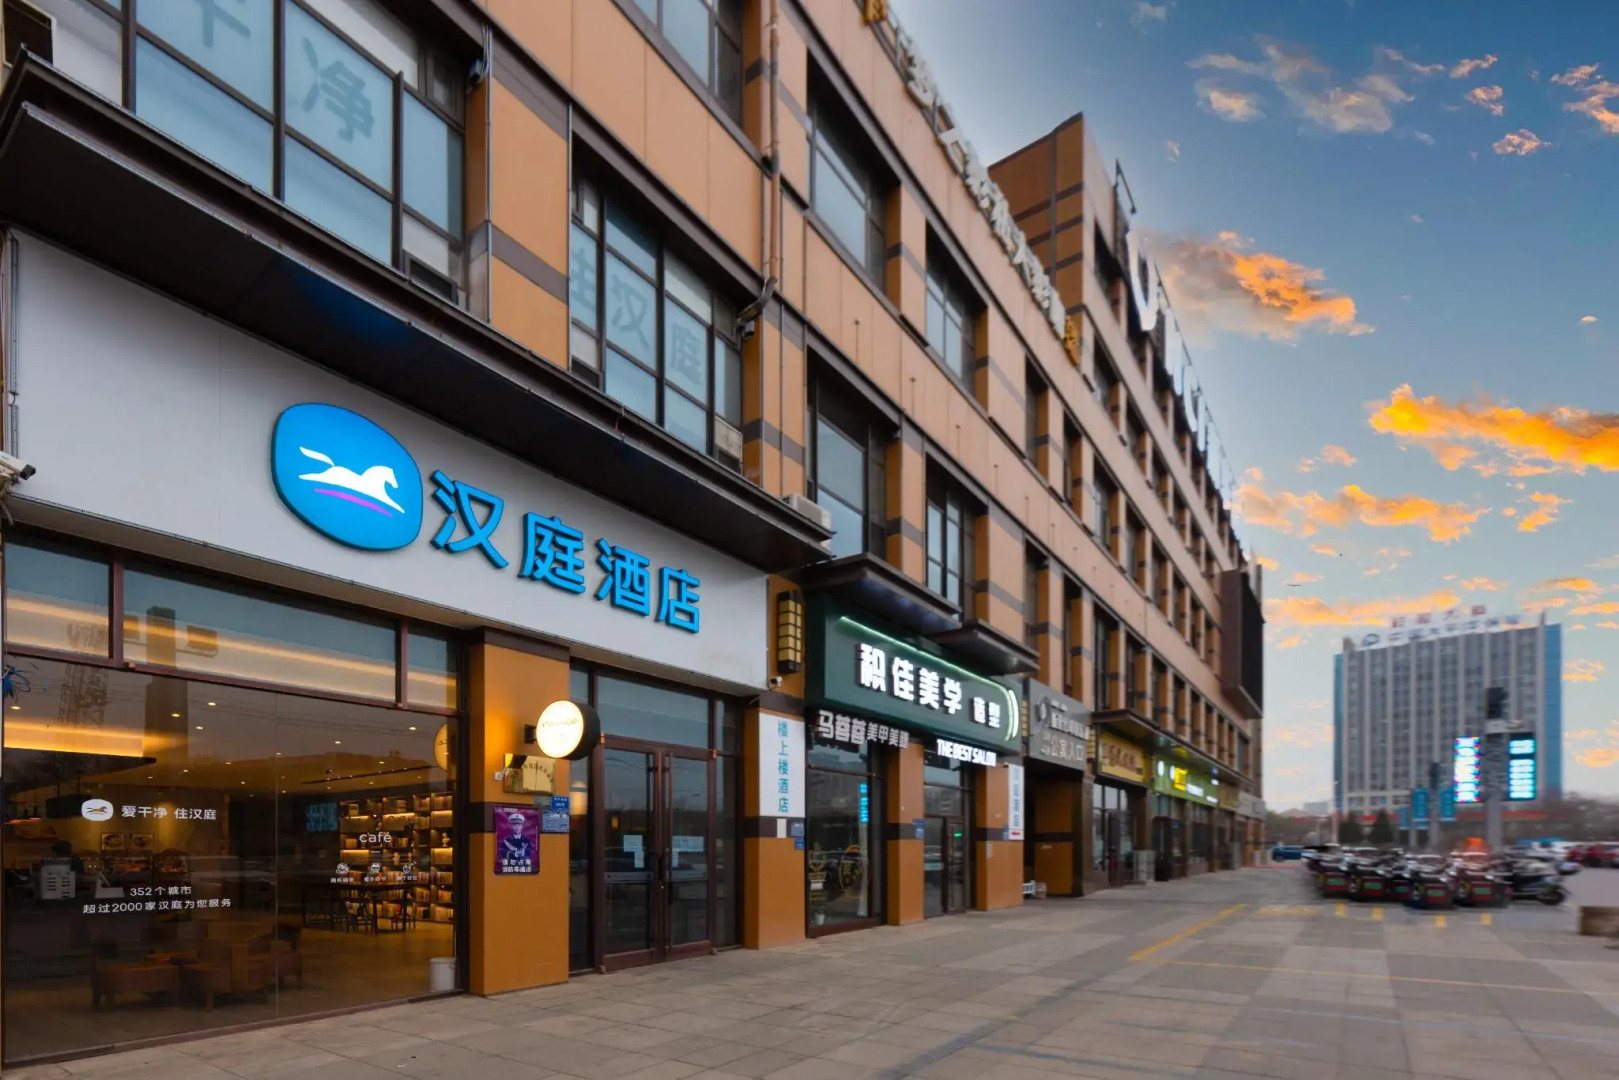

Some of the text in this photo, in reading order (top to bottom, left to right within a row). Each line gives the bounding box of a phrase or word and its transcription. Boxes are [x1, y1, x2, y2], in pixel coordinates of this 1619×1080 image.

[429, 468, 700, 634] 汉庭酒店
[858, 643, 962, 714] 积佳美学
[777, 720, 789, 813] 楼上楼酒店
[937, 738, 953, 757] THE
[953, 743, 973, 762] BEST
[121, 804, 217, 821] 爱干净 住汉庭
[359, 831, 392, 843] café
